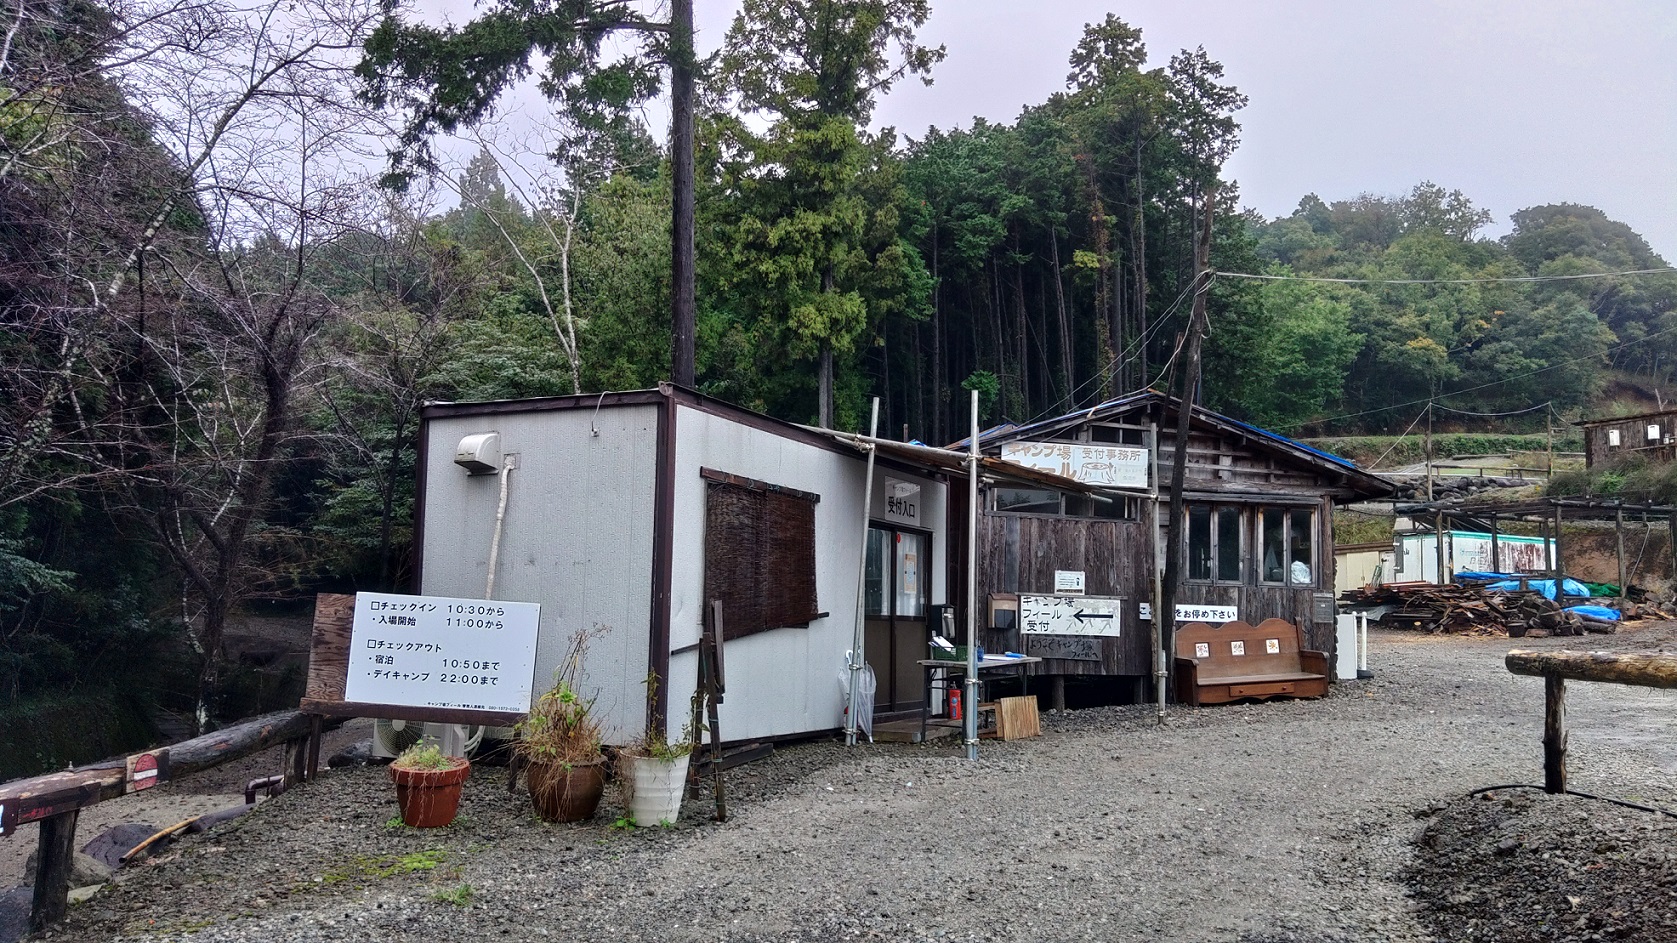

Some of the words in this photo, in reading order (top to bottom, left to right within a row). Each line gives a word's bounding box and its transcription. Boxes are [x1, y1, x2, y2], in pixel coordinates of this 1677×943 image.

[1008, 444, 1072, 461] キャンプ場
[1082, 447, 1141, 462] 受付事務所
[888, 496, 915, 519] 受付入口
[380, 601, 437, 613] チェックイン
[447, 604, 505, 617] 10:30から
[1022, 608, 1062, 620] フィール
[378, 615, 417, 627] 入場開始
[446, 617, 504, 630] 11:00から
[1026, 620, 1050, 632] 受付
[376, 640, 442, 653] チェックアウト
[375, 654, 394, 666] 宿泊
[442, 658, 501, 671] 10:50まで
[373, 669, 430, 682] デイキャンプ
[440, 673, 499, 686] 22:00まで
